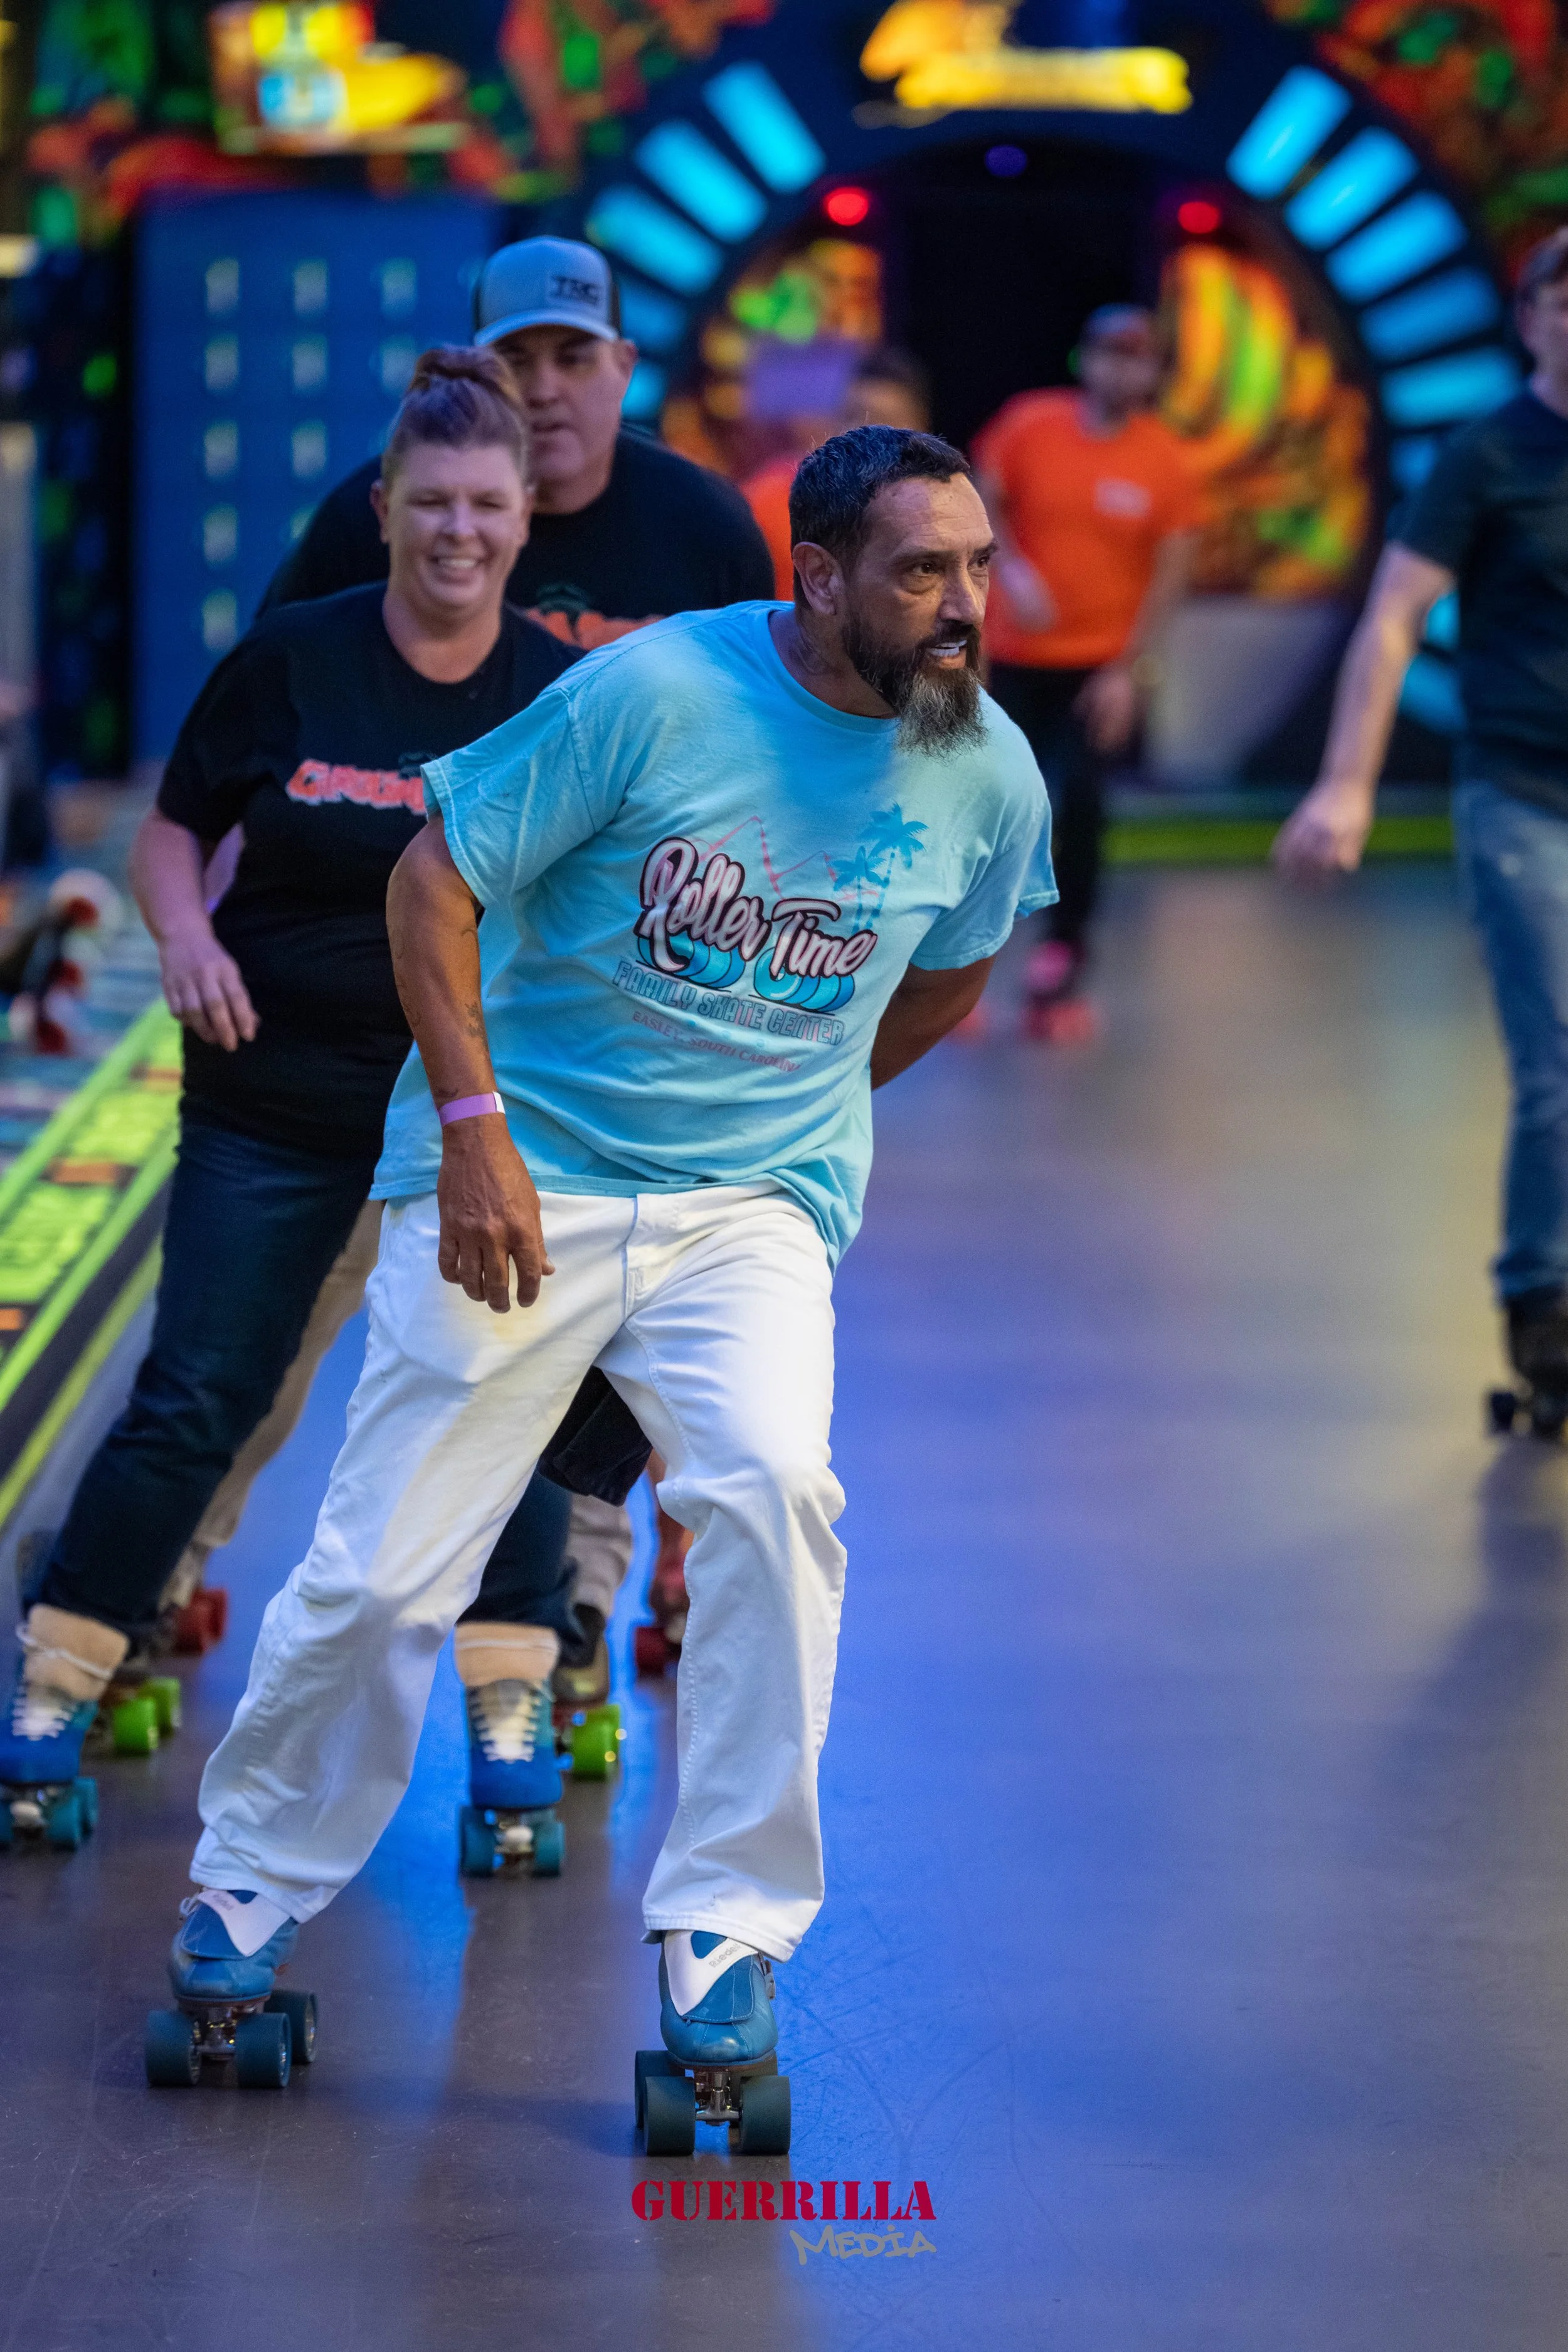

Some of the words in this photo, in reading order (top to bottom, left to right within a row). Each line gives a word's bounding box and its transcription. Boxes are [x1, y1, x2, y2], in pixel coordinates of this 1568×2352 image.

[633, 837, 771, 975] Roller
[771, 898, 878, 980] Time
[613, 961, 697, 1010] FAMILY
[697, 992, 766, 1030] SKATE
[767, 1007, 845, 1046] CENTER
